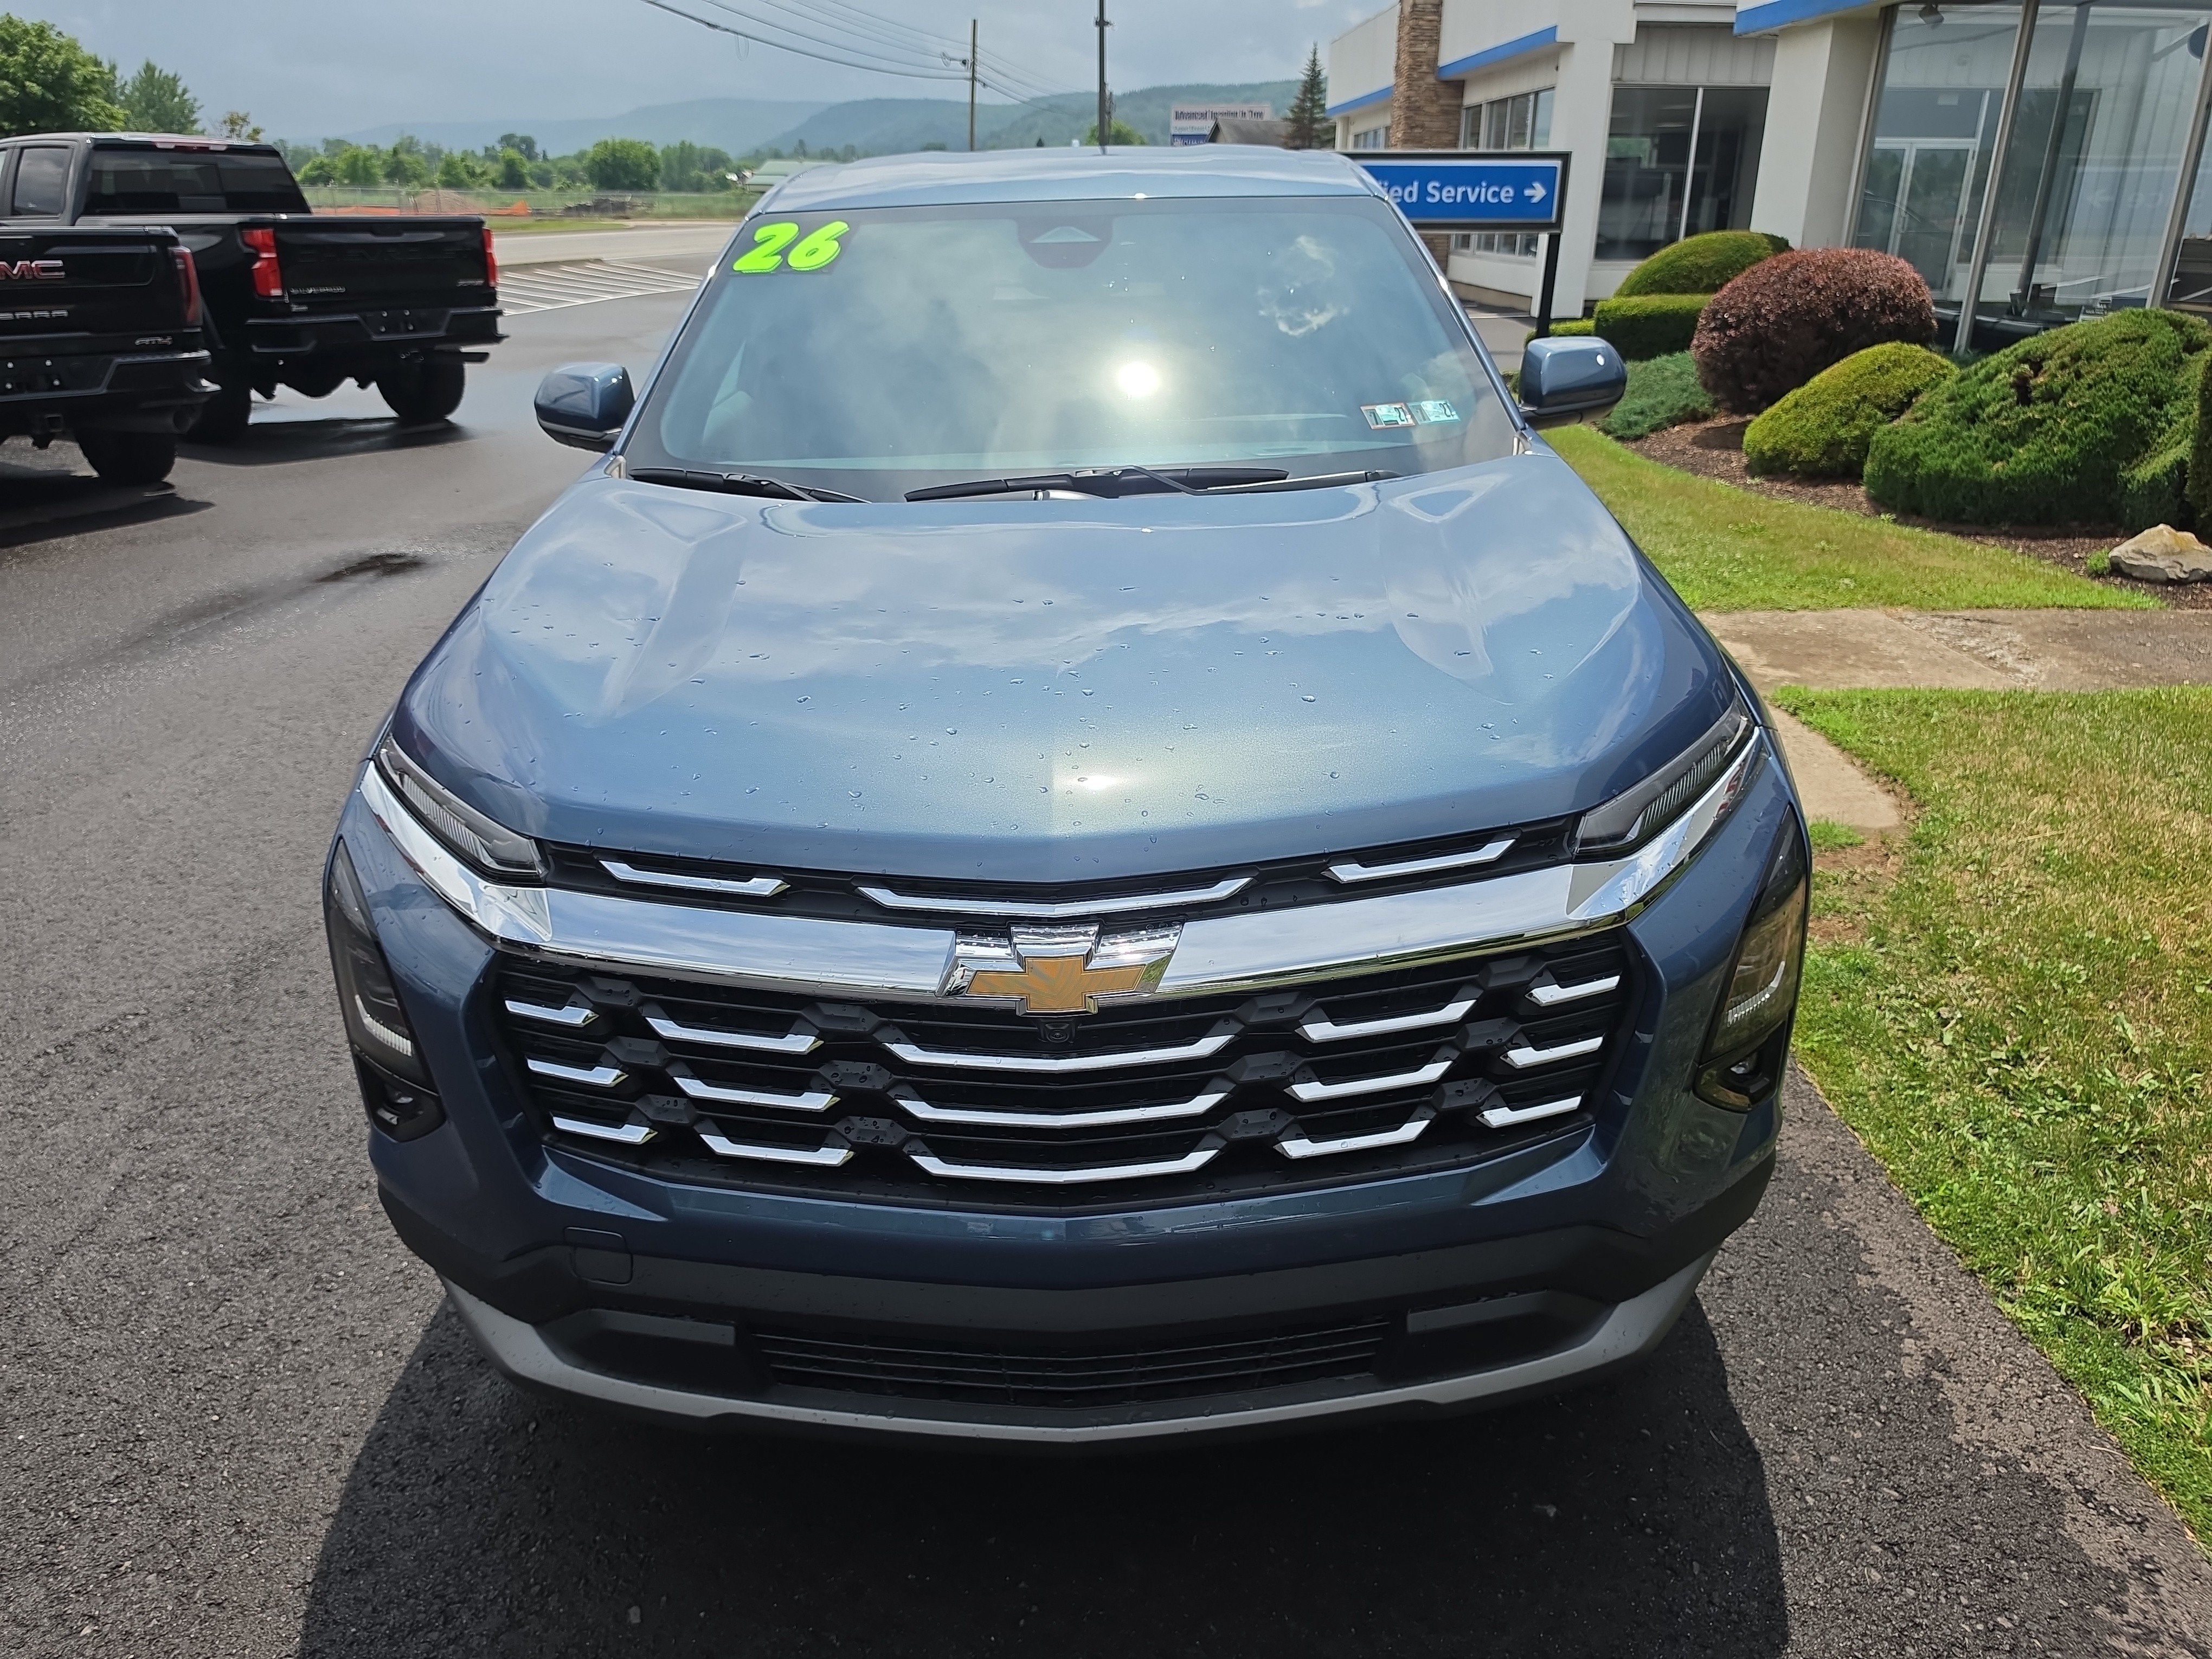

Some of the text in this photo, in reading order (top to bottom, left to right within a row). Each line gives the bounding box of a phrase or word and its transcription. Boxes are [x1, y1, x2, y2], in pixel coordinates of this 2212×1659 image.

[1426, 181, 1514, 203] Service
[732, 221, 850, 273] 26
[0, 260, 66, 280] MC
[0, 310, 68, 320] ERRA
